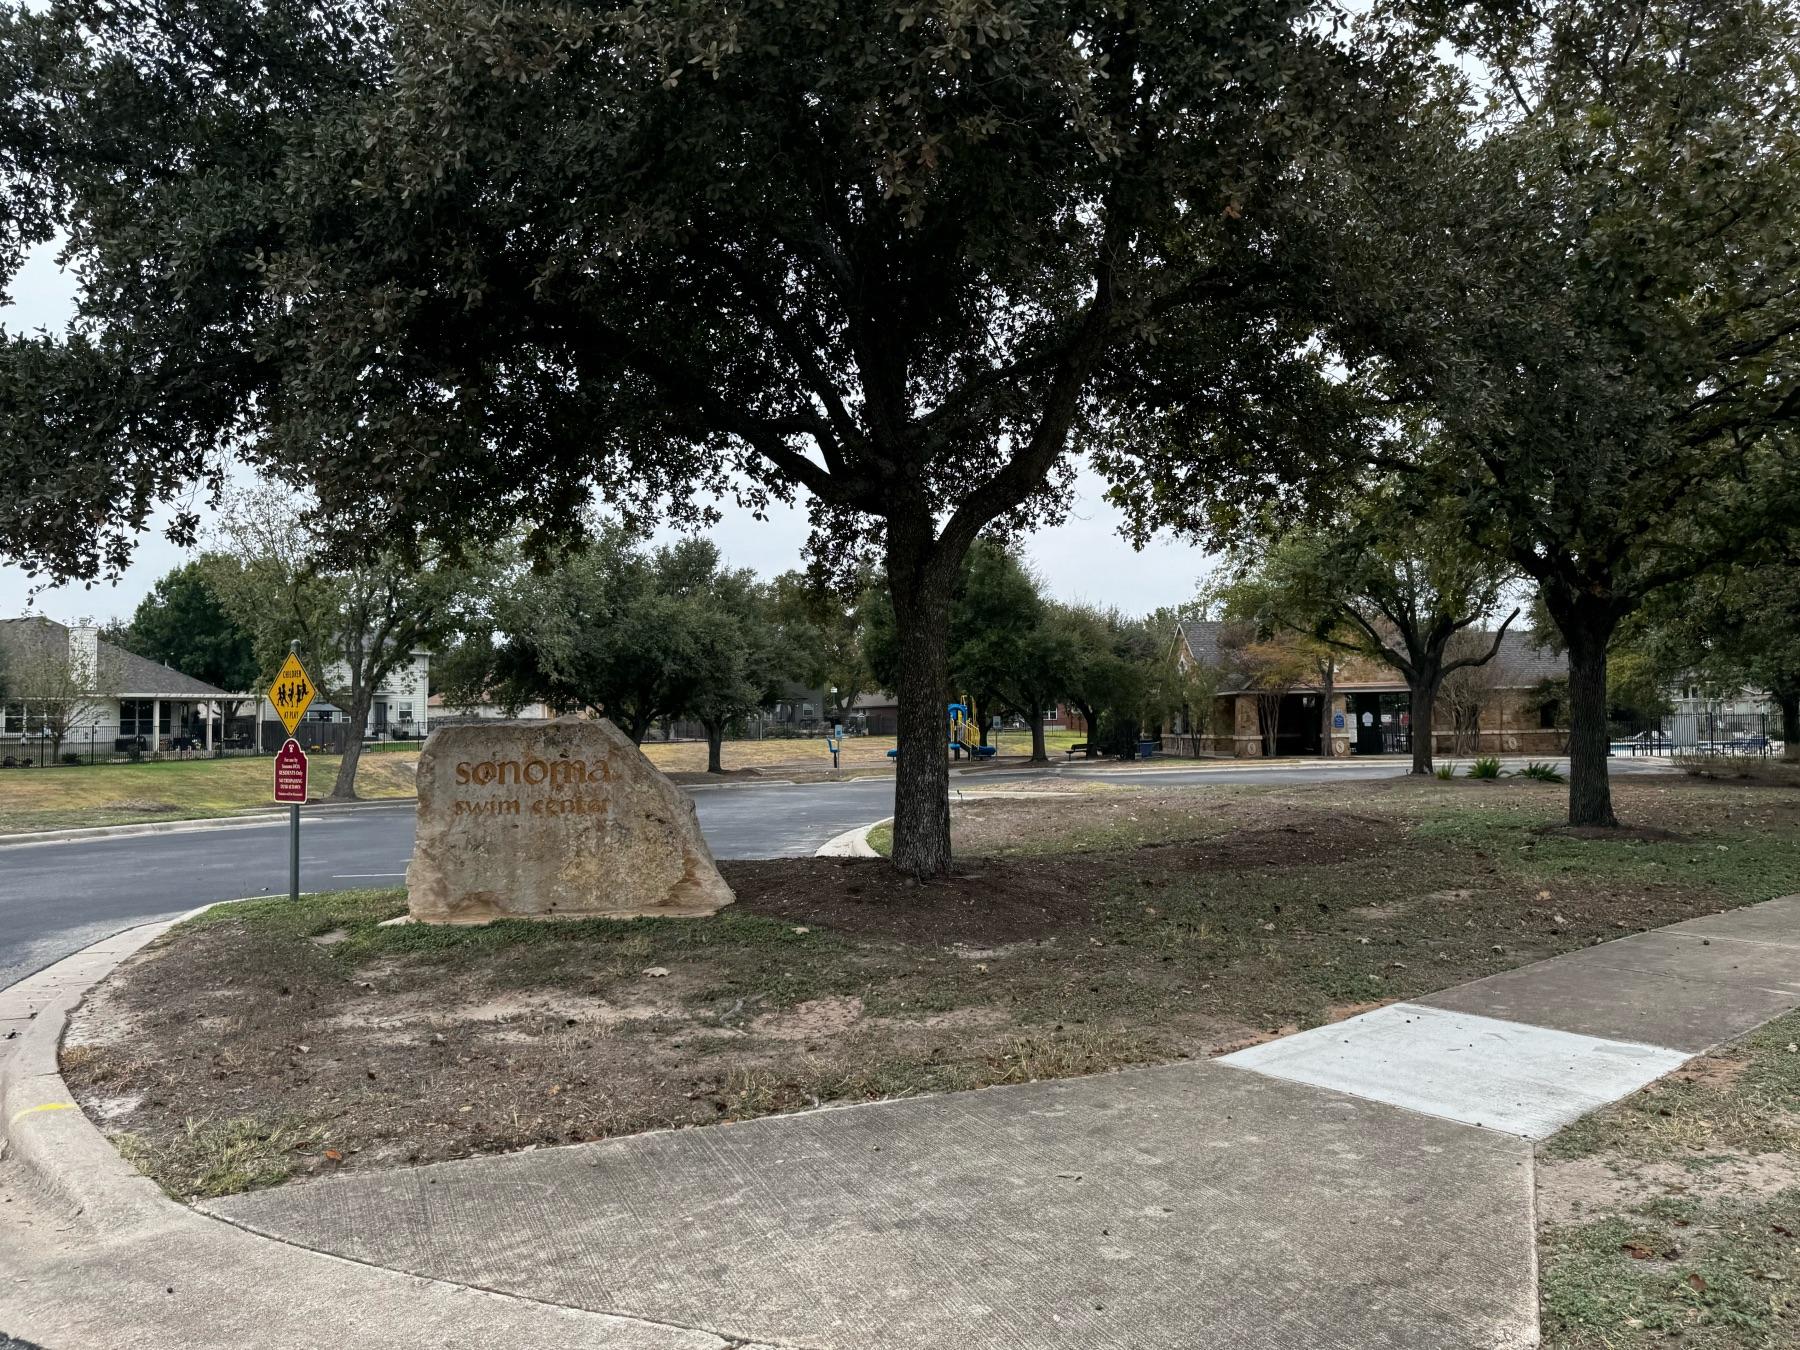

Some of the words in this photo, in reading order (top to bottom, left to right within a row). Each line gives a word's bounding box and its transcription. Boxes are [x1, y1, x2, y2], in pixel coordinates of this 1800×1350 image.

[282, 670, 302, 678] CHILDREN
[284, 710, 288, 720] AT
[290, 710, 298, 720] PLAY
[455, 759, 612, 786] sonoma
[454, 797, 520, 817] swim
[531, 796, 612, 818] center
